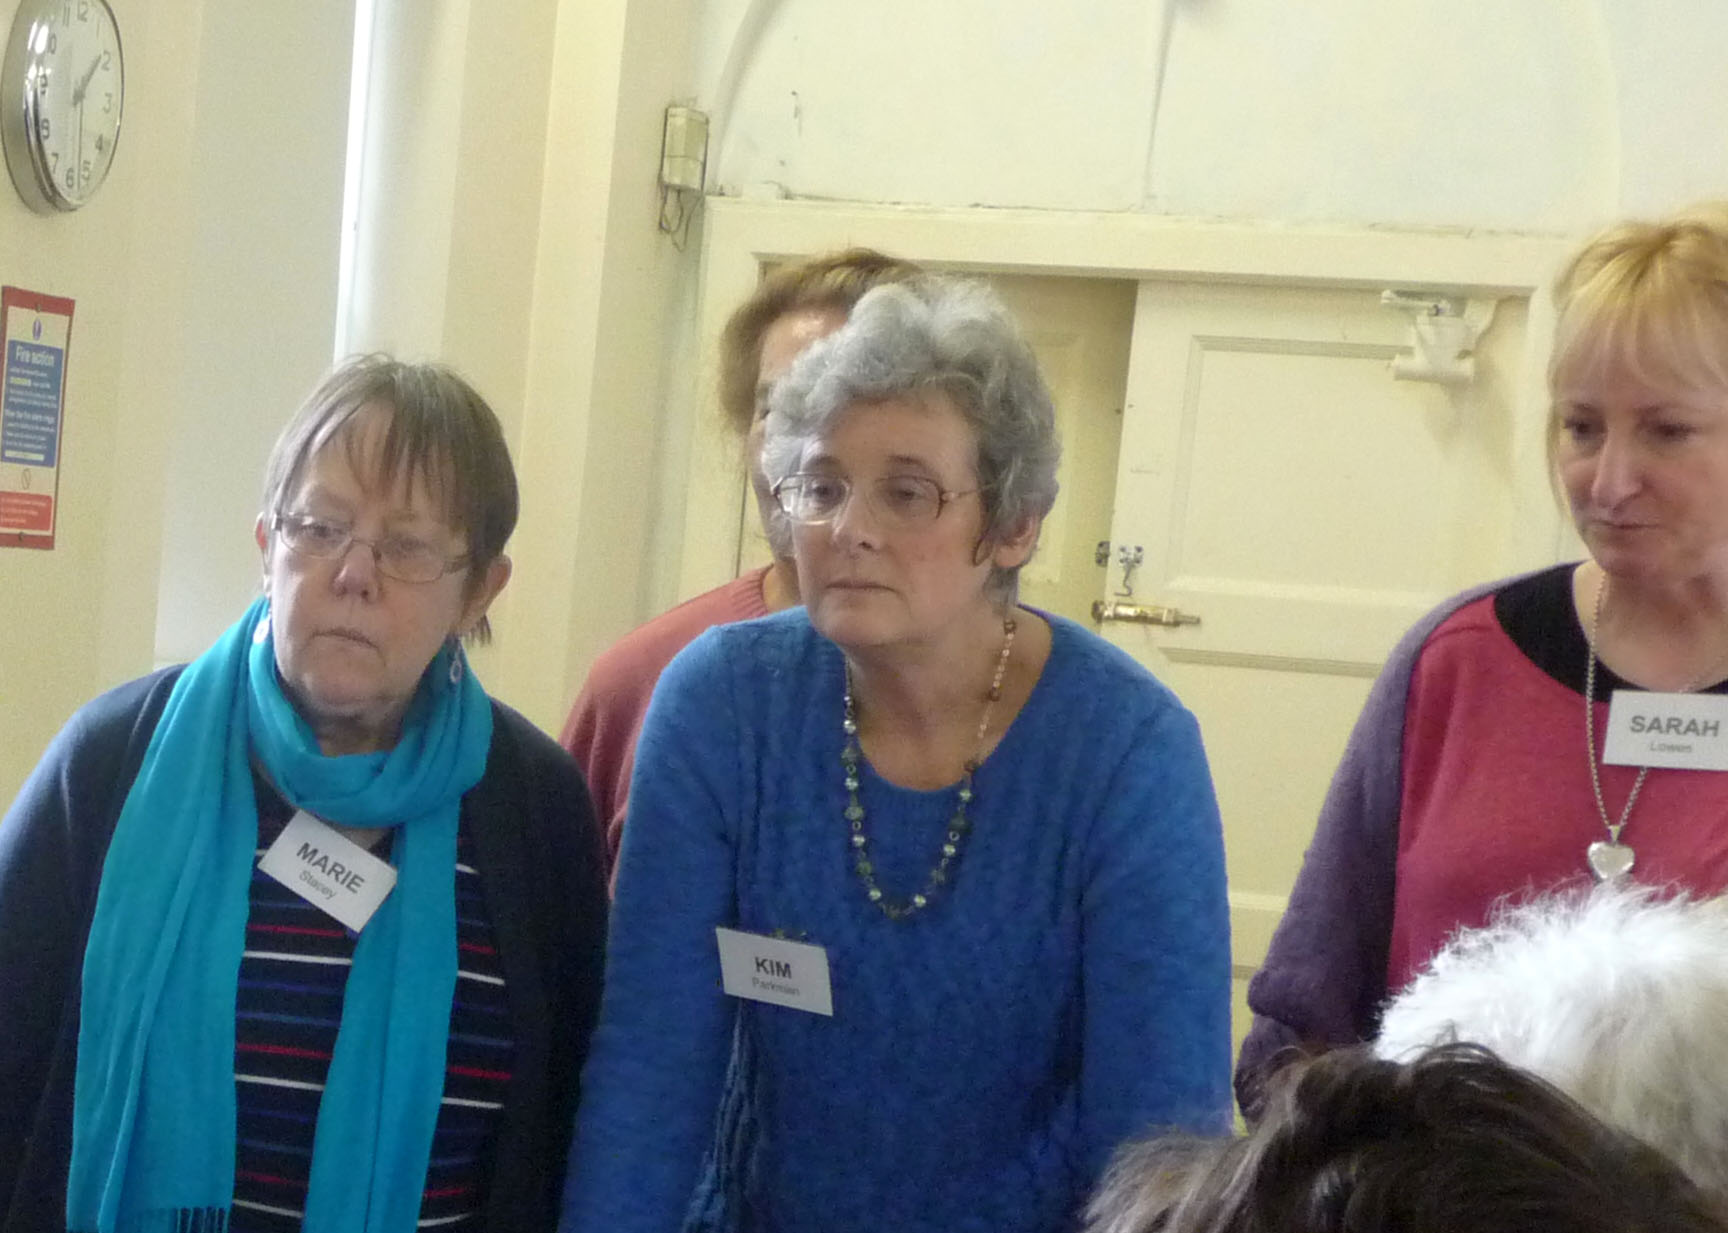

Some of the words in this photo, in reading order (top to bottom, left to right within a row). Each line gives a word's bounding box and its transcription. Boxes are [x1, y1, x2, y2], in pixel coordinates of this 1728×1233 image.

[77, 0, 88, 22] 12
[101, 49, 112, 71] 2
[103, 91, 113, 114] 3
[41, 118, 50, 140] 8
[94, 133, 103, 152] 4
[51, 152, 59, 175] 7
[82, 160, 91, 181] 5
[66, 167, 74, 189] 6
[1630, 715, 1720, 737] SARAH
[296, 842, 366, 894] MARIE
[755, 956, 792, 979] KIM
